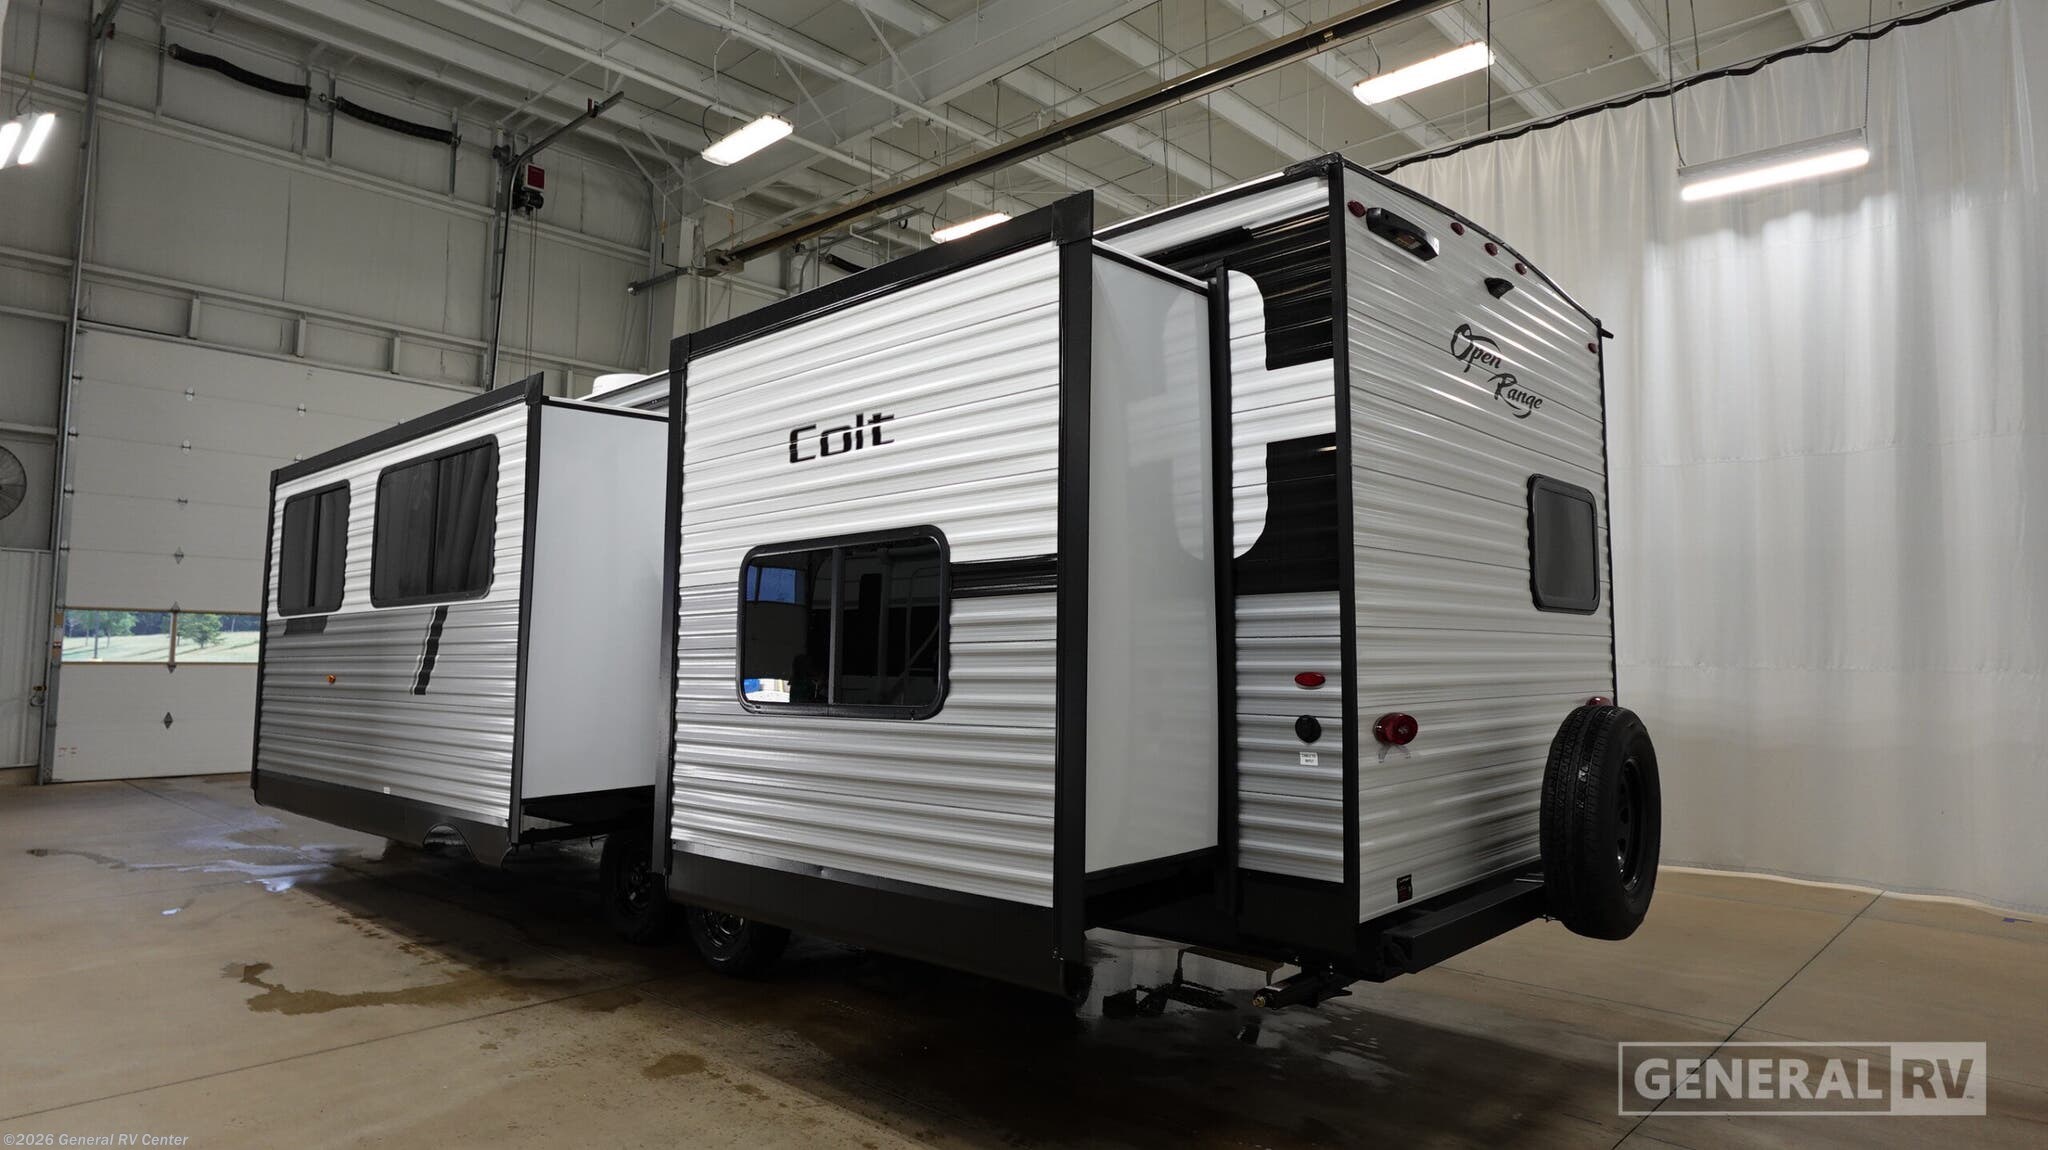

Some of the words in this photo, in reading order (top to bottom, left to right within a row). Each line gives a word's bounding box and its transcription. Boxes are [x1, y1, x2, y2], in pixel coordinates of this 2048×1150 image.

[1450, 323, 1501, 373] Open
[1487, 372, 1543, 419] Range
[789, 412, 895, 463] Colt
